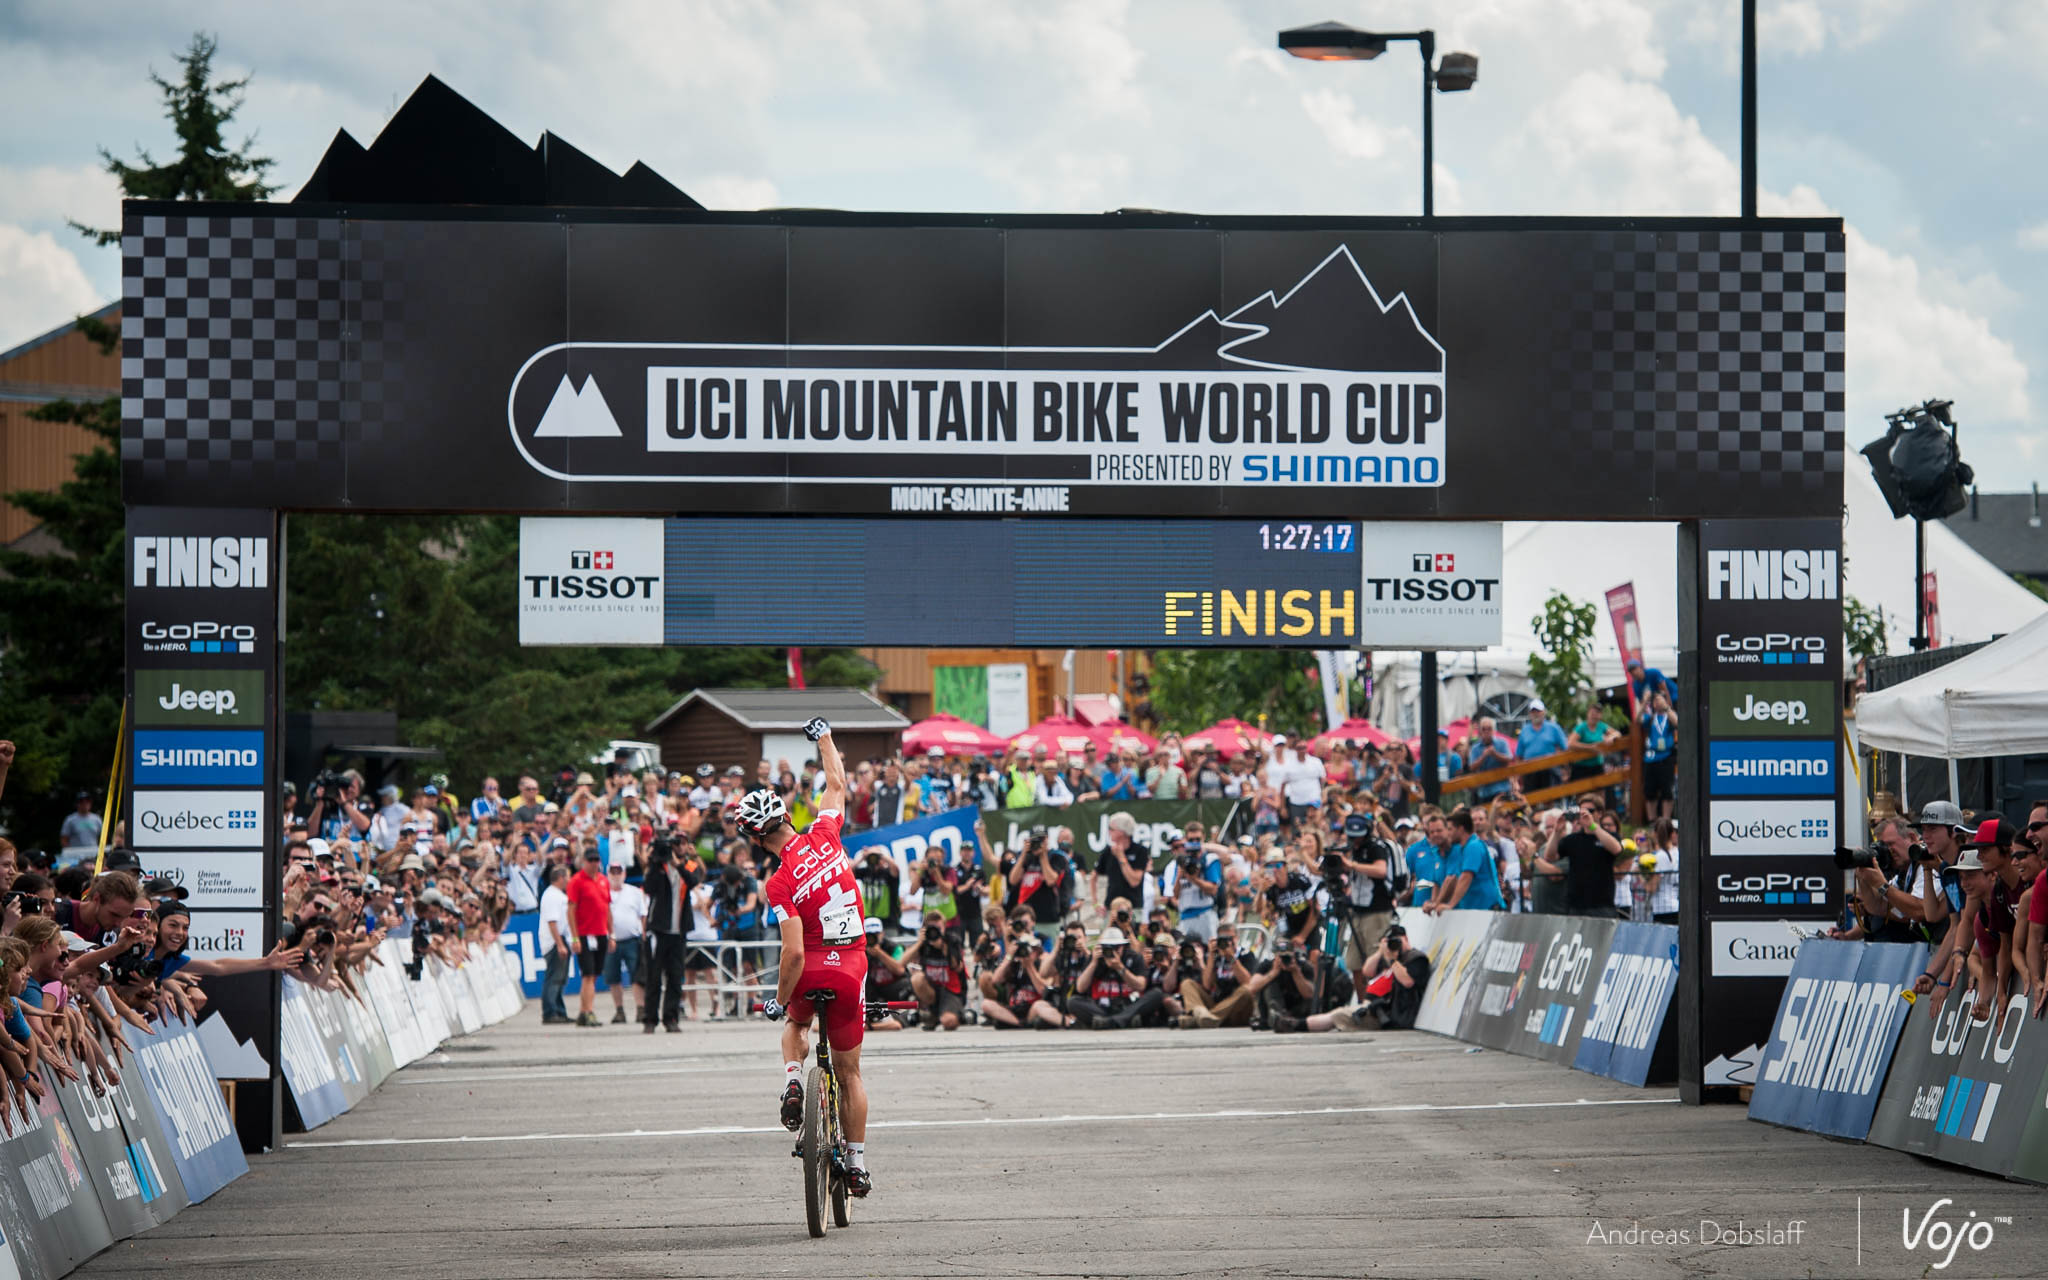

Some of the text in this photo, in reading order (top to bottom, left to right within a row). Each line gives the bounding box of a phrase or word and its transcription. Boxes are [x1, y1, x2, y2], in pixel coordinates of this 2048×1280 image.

[665, 377, 1443, 445] UCI MOUNTAIN BIKE WORLD CUP
[1097, 454, 1439, 483] PRESENTED BY SHIMANO
[891, 486, 1070, 512] MONT-SAINTE-ANNE
[1259, 524, 1353, 550] 1:27:17
[133, 536, 268, 588] FINISH
[1707, 549, 1838, 600] FINISH
[524, 576, 659, 599] TISSOT
[1367, 579, 1499, 601] TISSOT
[1165, 589, 1355, 637] FINISH
[1400, 607, 1443, 615] WATCHES
[1448, 607, 1474, 615] SINCE
[142, 622, 256, 639] GoPro
[1716, 633, 1825, 651] GoPro
[159, 683, 236, 715] Jeep
[1733, 694, 1807, 725] Jeep
[141, 749, 257, 767] SHIMANO
[1716, 759, 1828, 776] SHIMANO
[141, 810, 224, 832] Québec
[1717, 820, 1798, 842] Québec
[1087, 813, 1176, 858] Jep
[153, 867, 179, 879] uci
[197, 878, 232, 888] Cycliste
[1717, 873, 1826, 891] GoPro
[197, 886, 256, 894] Internationale
[185, 928, 244, 951] nada
[840, 921, 848, 935] 2
[1728, 937, 1800, 961] Cana
[1538, 932, 1593, 995] GoPro
[1582, 953, 1673, 1050] SHIMANO
[1764, 977, 1903, 1096] SHIMANO
[140, 1032, 231, 1160] SHIMANO
